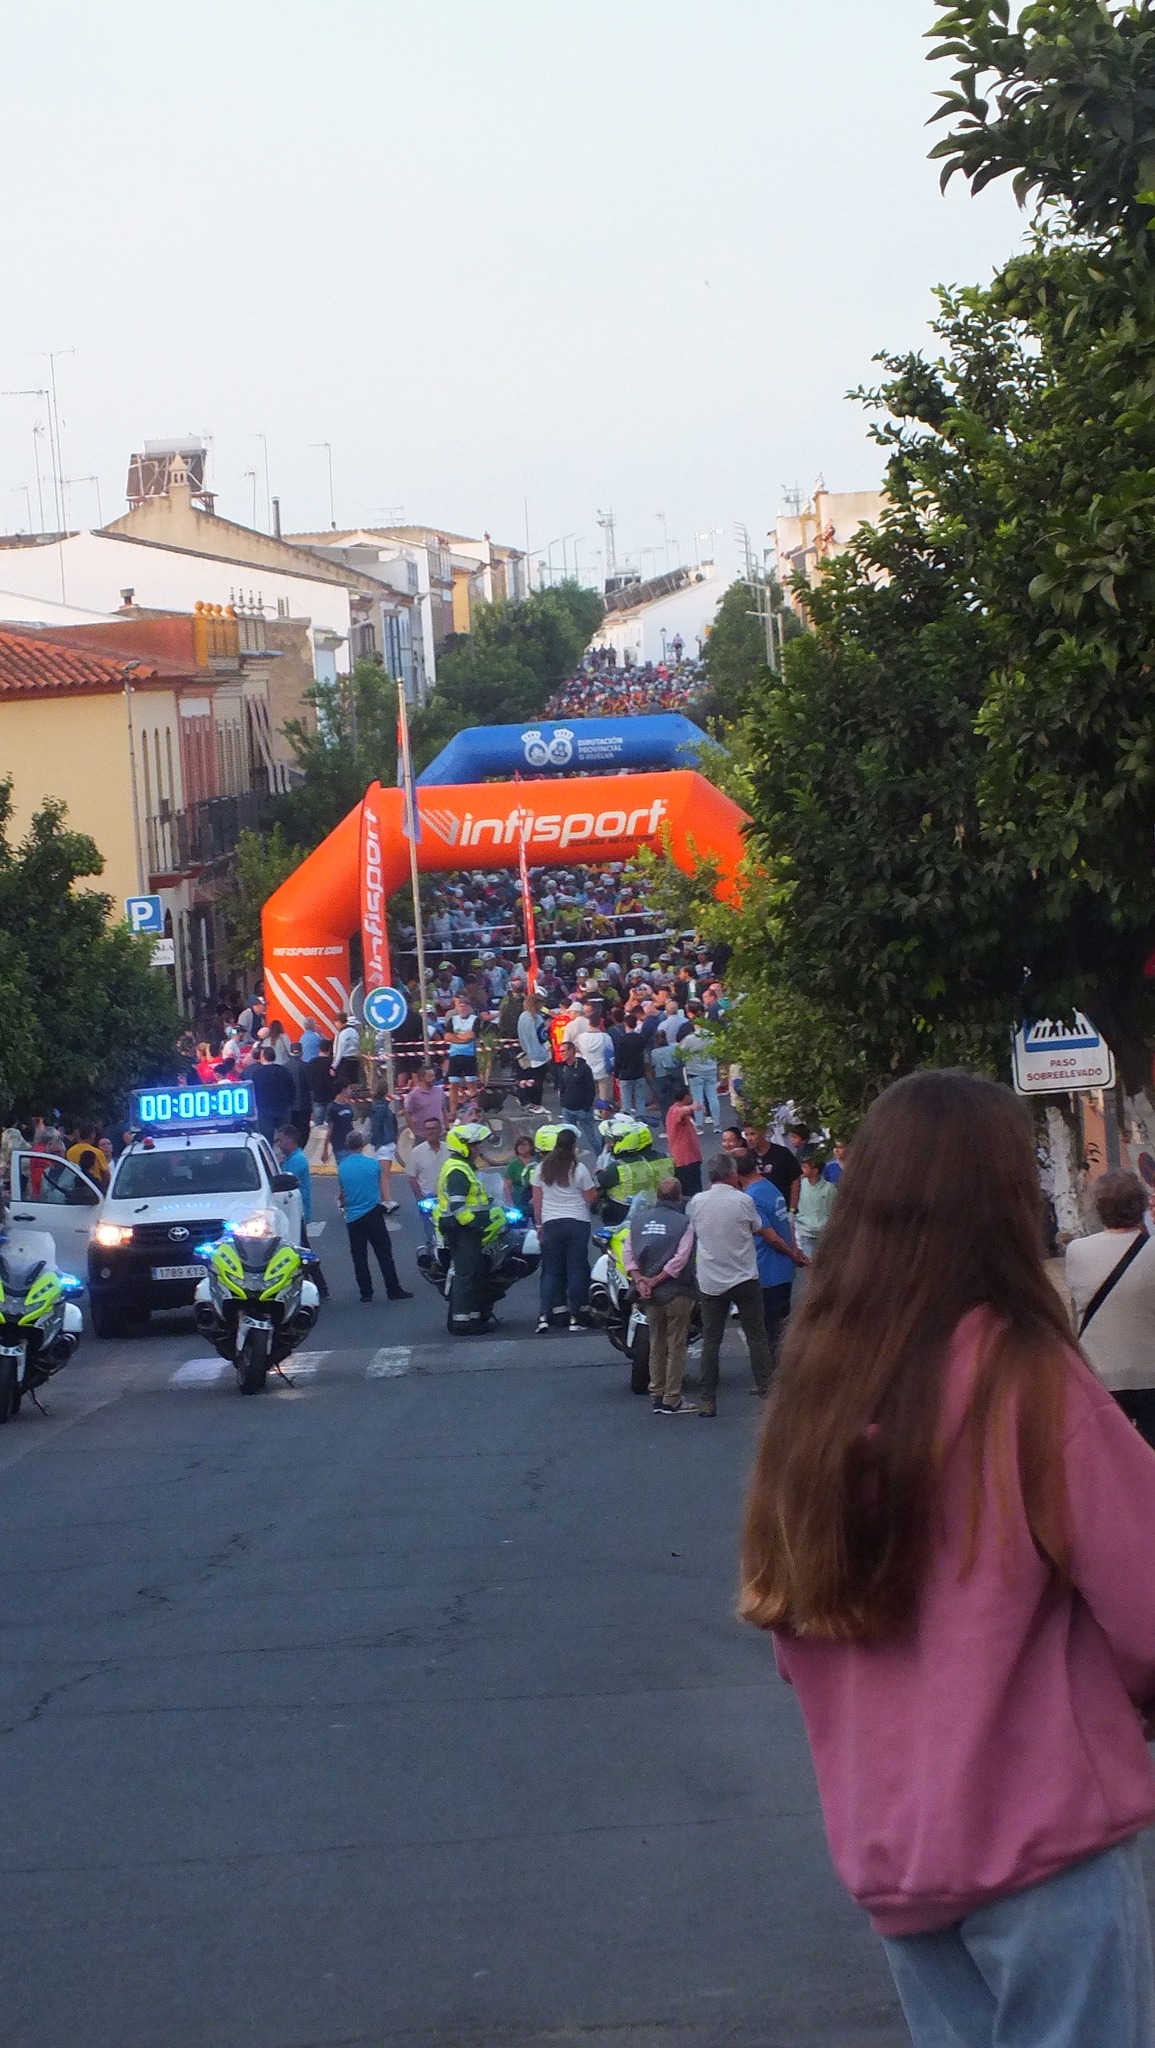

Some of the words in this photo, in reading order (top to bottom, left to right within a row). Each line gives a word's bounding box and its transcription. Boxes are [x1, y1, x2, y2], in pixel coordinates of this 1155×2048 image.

[577, 736, 623, 746] DIPUTACIÓN
[578, 744, 623, 753] PROVINCIAL
[459, 799, 667, 848] infisport
[364, 806, 383, 971] infisport
[131, 901, 153, 931] P
[272, 945, 344, 957] INFISPORT.COM
[1050, 1058, 1077, 1067] PASO
[1026, 1068, 1103, 1081] SOBREELEVADO
[140, 1088, 249, 1121] 00:00:00
[160, 1268, 183, 1278] 1789
